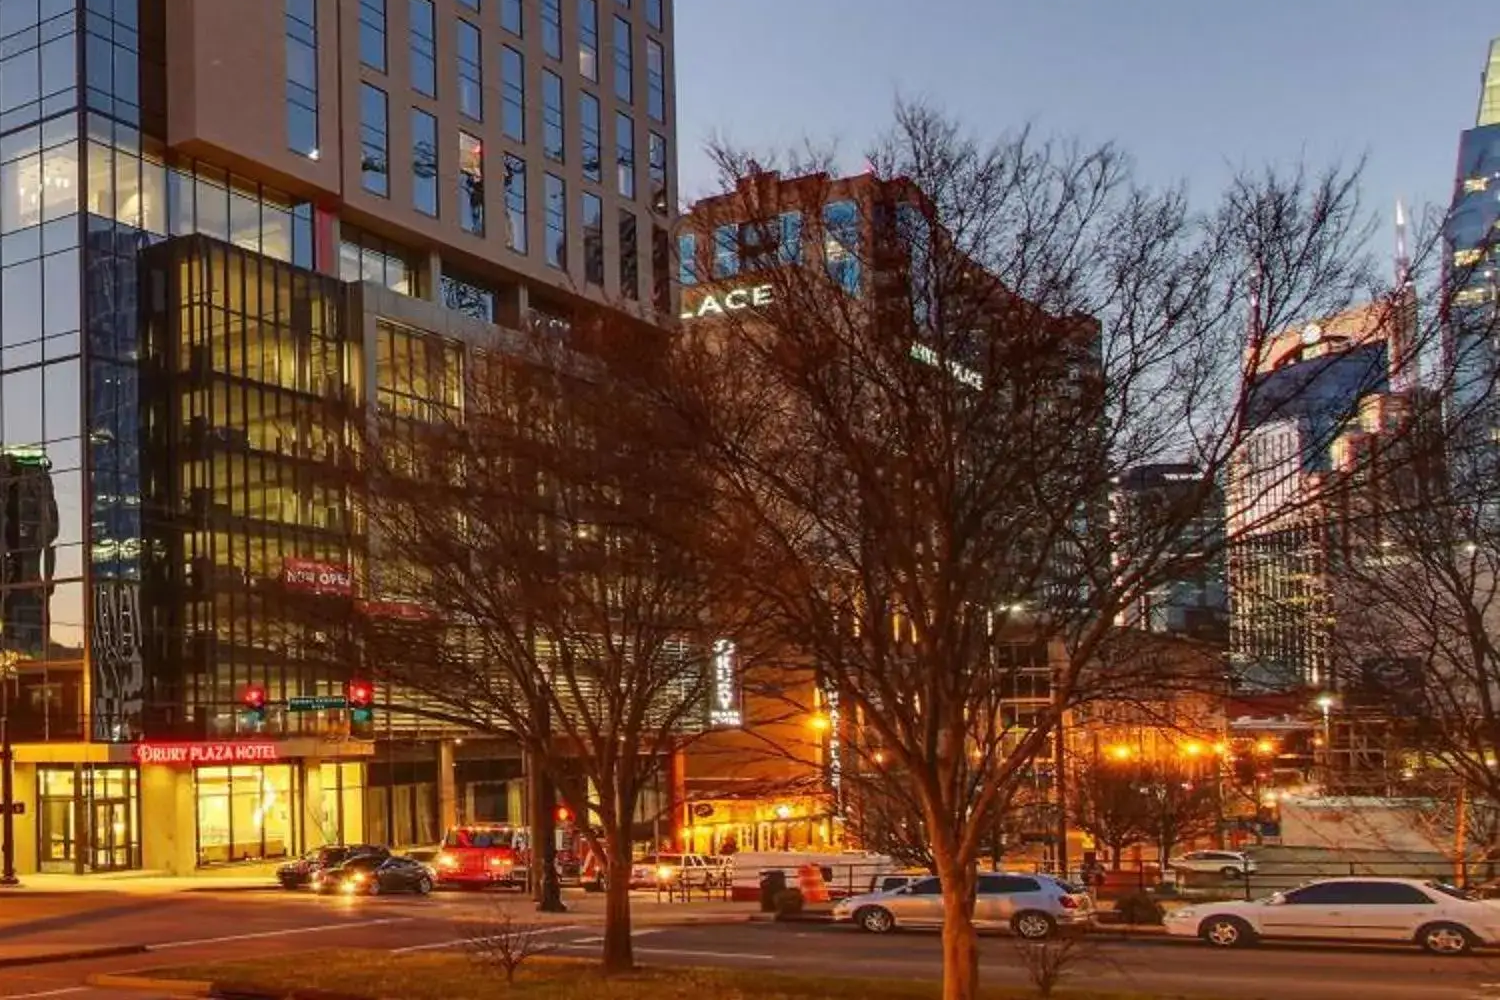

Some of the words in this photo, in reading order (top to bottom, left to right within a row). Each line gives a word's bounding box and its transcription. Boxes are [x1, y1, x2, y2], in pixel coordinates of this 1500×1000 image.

[137, 744, 188, 762] DRURY
[190, 746, 234, 761] PLAZA
[235, 744, 277, 760] HOTEL
